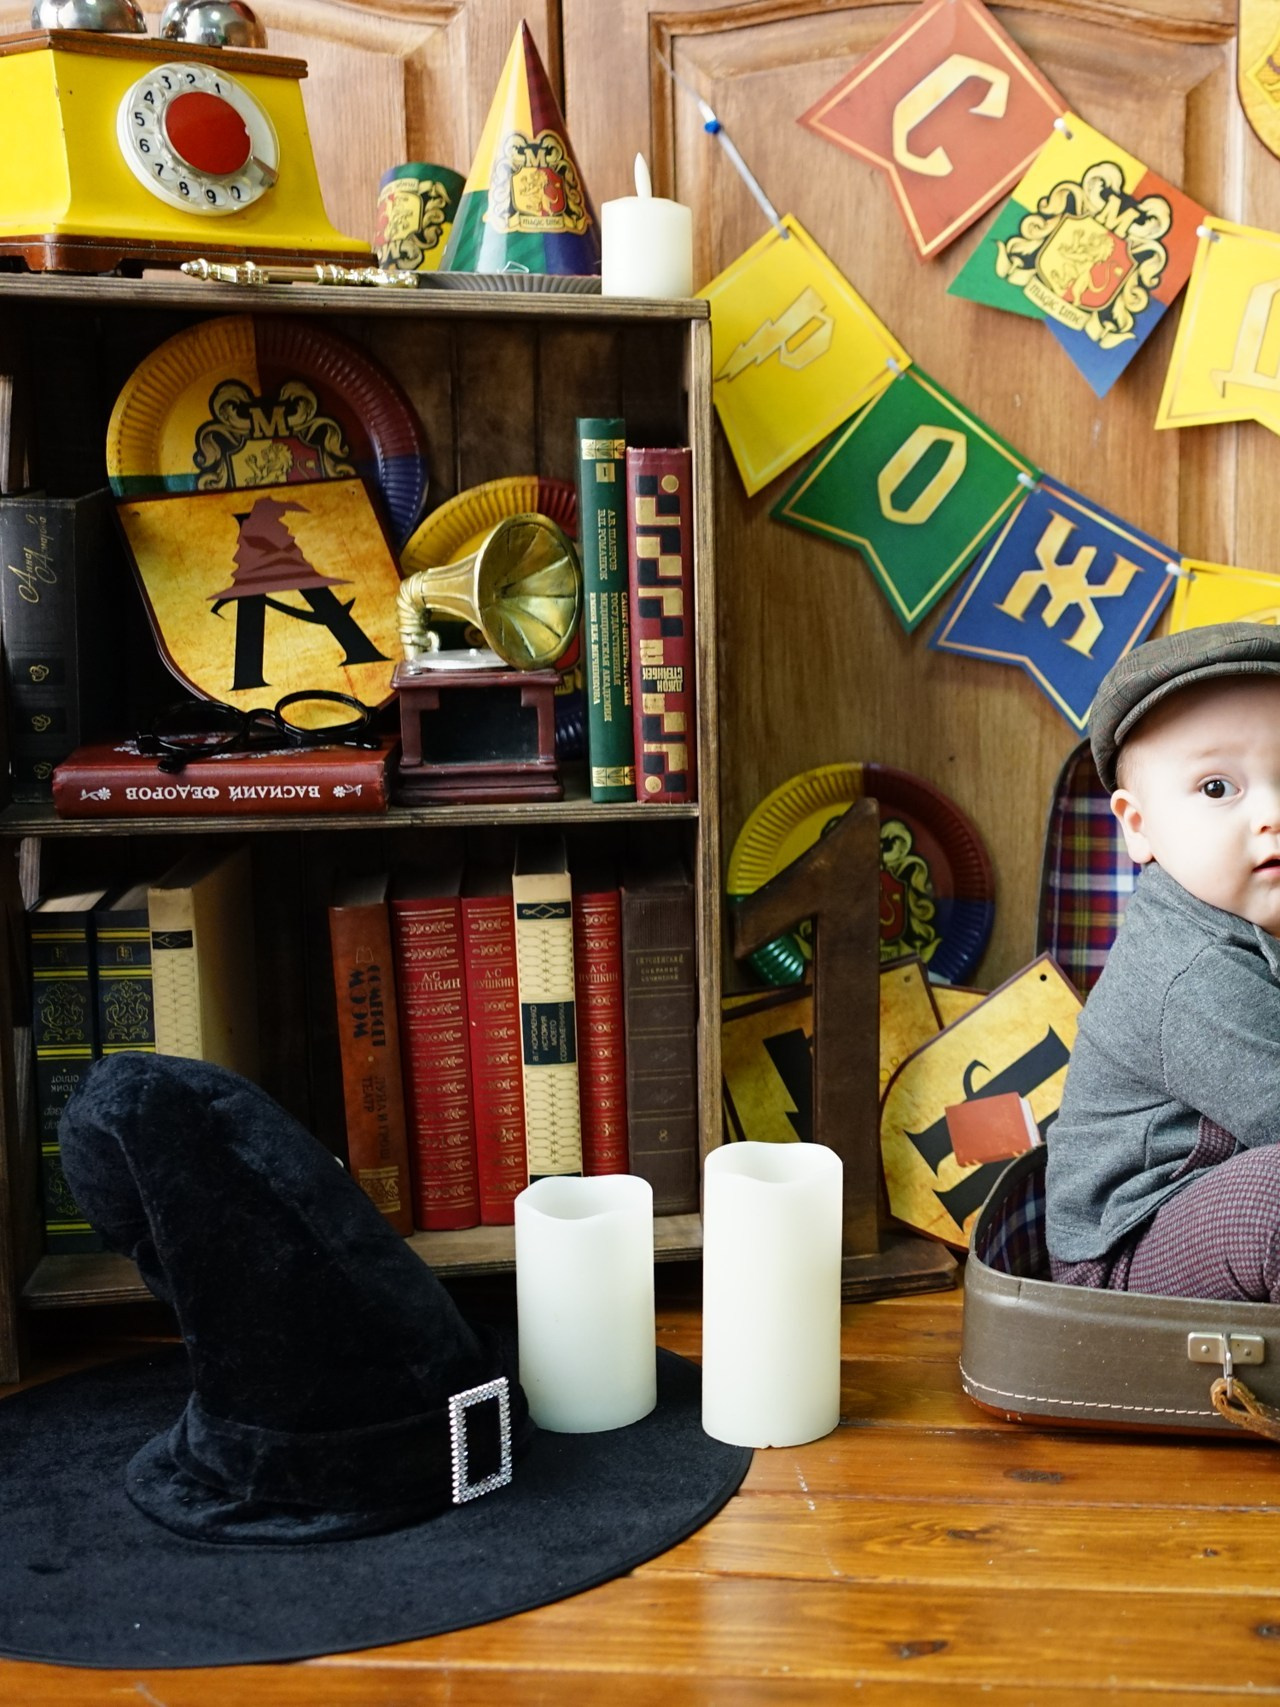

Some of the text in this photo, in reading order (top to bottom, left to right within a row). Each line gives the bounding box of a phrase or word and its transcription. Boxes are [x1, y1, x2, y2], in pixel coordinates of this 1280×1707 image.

[161, 76, 172, 89] 3
[215, 83, 221, 93] 1
[144, 90, 154, 104] 4
[134, 112, 145, 127] 5
[892, 54, 1010, 176] С
[139, 139, 150, 153] 6
[524, 148, 547, 168] M
[155, 163, 164, 176] 7
[179, 181, 190, 196] 8
[206, 189, 217, 204] 9
[1094, 194, 1140, 238] M
[1029, 284, 1056, 310] magic
[252, 407, 291, 437] M
[126, 784, 320, 801] ВАСИЛИЙ ФЕДОРОВ
[658, 1128, 668, 1142] 8
